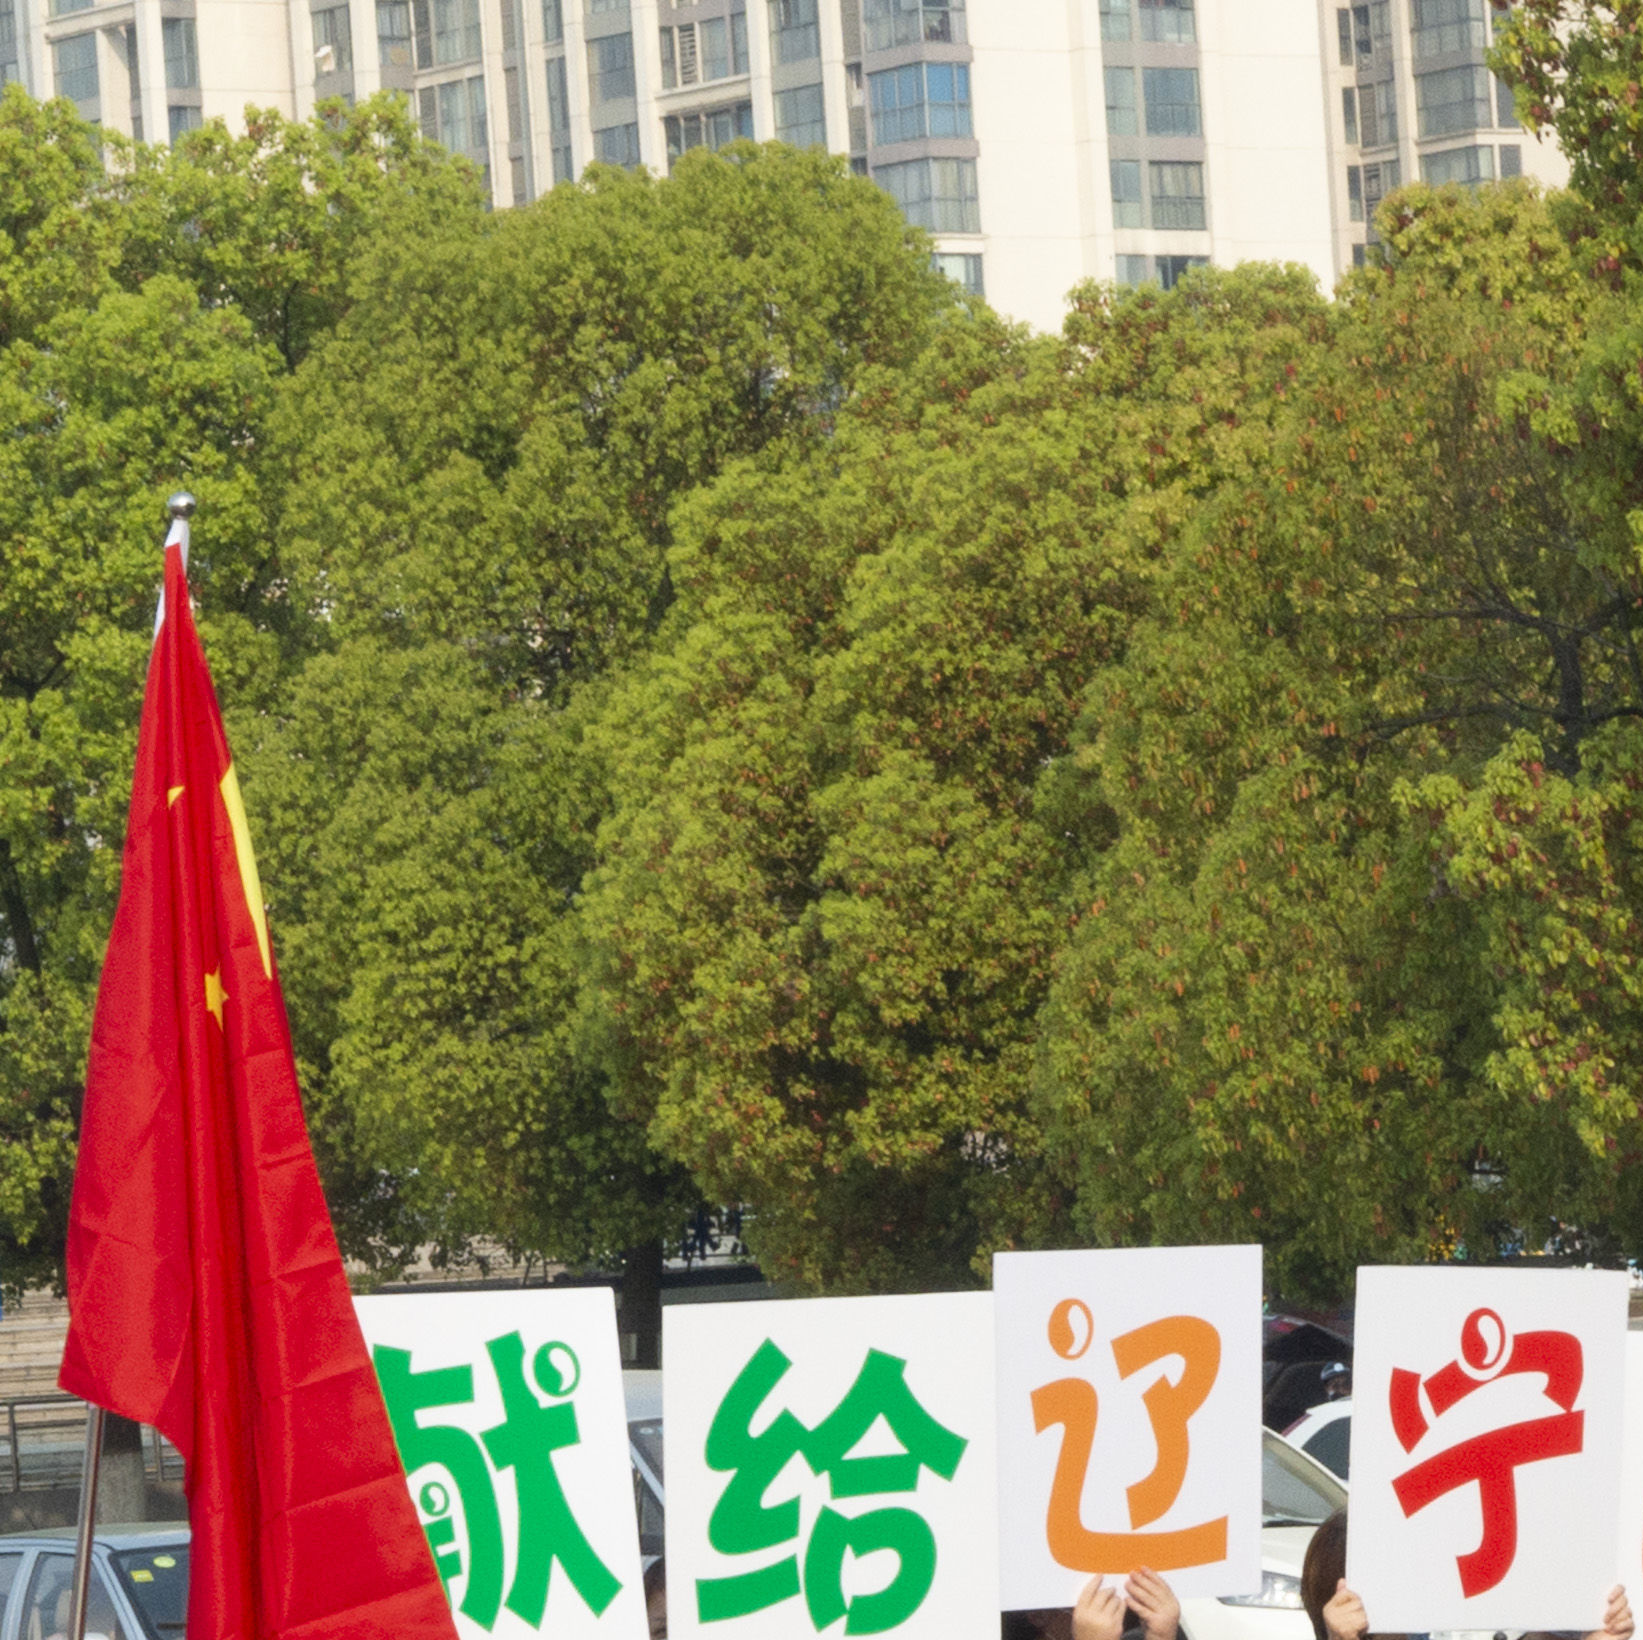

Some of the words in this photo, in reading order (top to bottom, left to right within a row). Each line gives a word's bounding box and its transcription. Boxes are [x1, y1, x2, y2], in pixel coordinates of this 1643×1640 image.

[697, 1341, 966, 1635] 给
[1032, 1300, 1227, 1574] 辽
[1390, 1309, 1583, 1597] 宁
